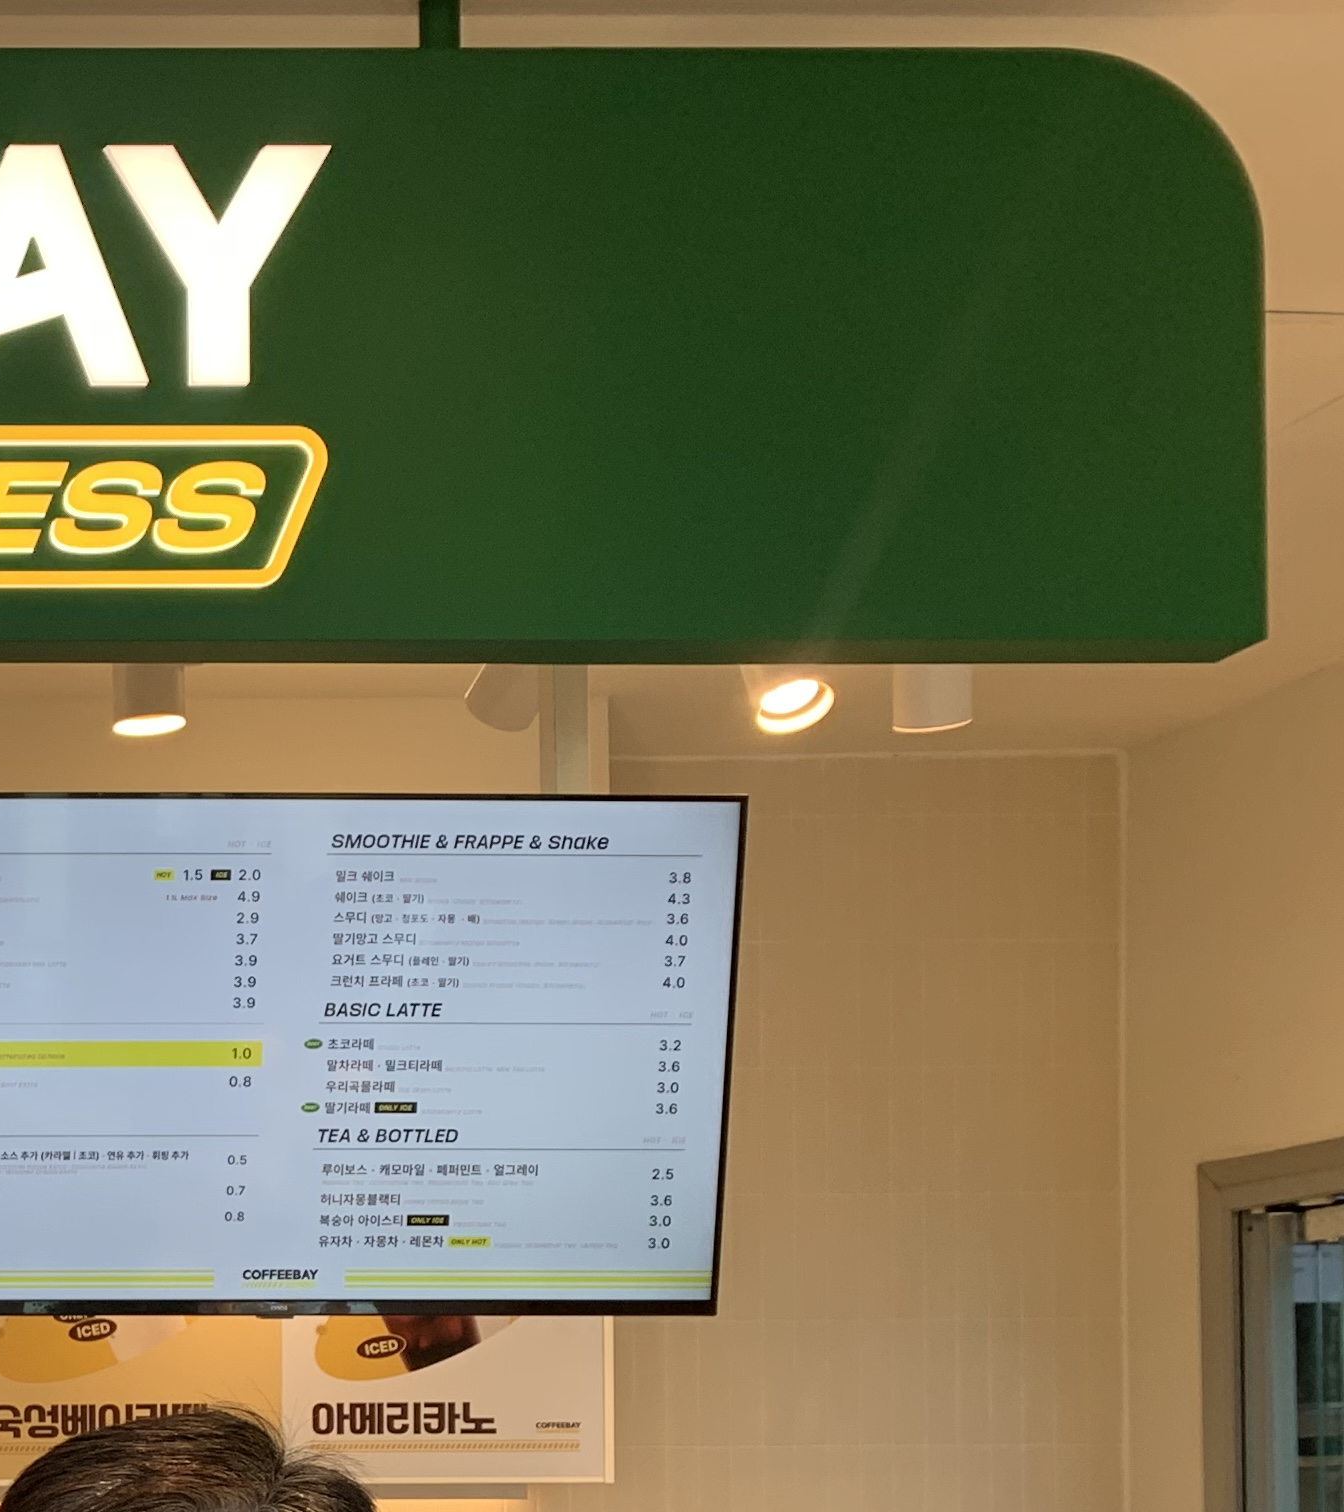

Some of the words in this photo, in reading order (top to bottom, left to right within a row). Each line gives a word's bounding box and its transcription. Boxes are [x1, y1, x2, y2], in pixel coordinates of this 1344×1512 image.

[331, 834, 431, 850] SMOOTHIE
[436, 835, 449, 849] &
[453, 835, 525, 850] FRAPPE
[529, 836, 542, 850] &
[548, 835, 609, 850] Shake
[183, 869, 203, 881] 1.5
[238, 869, 261, 881] 2.0
[336, 870, 358, 882] 밀크
[361, 870, 395, 883] 쉐이크
[669, 872, 692, 884] 3.8
[236, 912, 260, 924] 2.9
[236, 933, 258, 945] 3.7
[333, 933, 378, 946] 딸기망고
[382, 933, 417, 946] 스무디
[665, 935, 688, 946] 4.0
[234, 955, 257, 967] 3.9
[233, 976, 256, 988] 3.9
[232, 998, 256, 1009] 3.9
[324, 1002, 381, 1018] BASIC
[386, 1003, 443, 1018] LATTE
[328, 1038, 375, 1051] 초코라떼
[659, 1040, 682, 1052] 3.2
[232, 1048, 252, 1059] 1.0
[327, 1059, 374, 1072] 말차라떼
[385, 1059, 443, 1072] 밀크티라떼
[658, 1061, 680, 1073] 3.6
[325, 1081, 396, 1093] 우리곡물라떼
[657, 1082, 679, 1094] 3.0
[325, 1102, 371, 1114] 딸기라떼
[655, 1103, 678, 1115] 3.6
[318, 1129, 352, 1144] TEA
[356, 1129, 370, 1144] &
[375, 1129, 459, 1144] BOTTLED
[320, 1214, 354, 1226] 복숭아
[358, 1214, 403, 1226] 아이스티
[649, 1215, 672, 1227] 3.0
[243, 1269, 318, 1280] COFFEEBAY
[76, 1321, 111, 1338] ICED
[364, 1338, 399, 1355] ICED
[312, 1402, 497, 1435] 아메리카노
